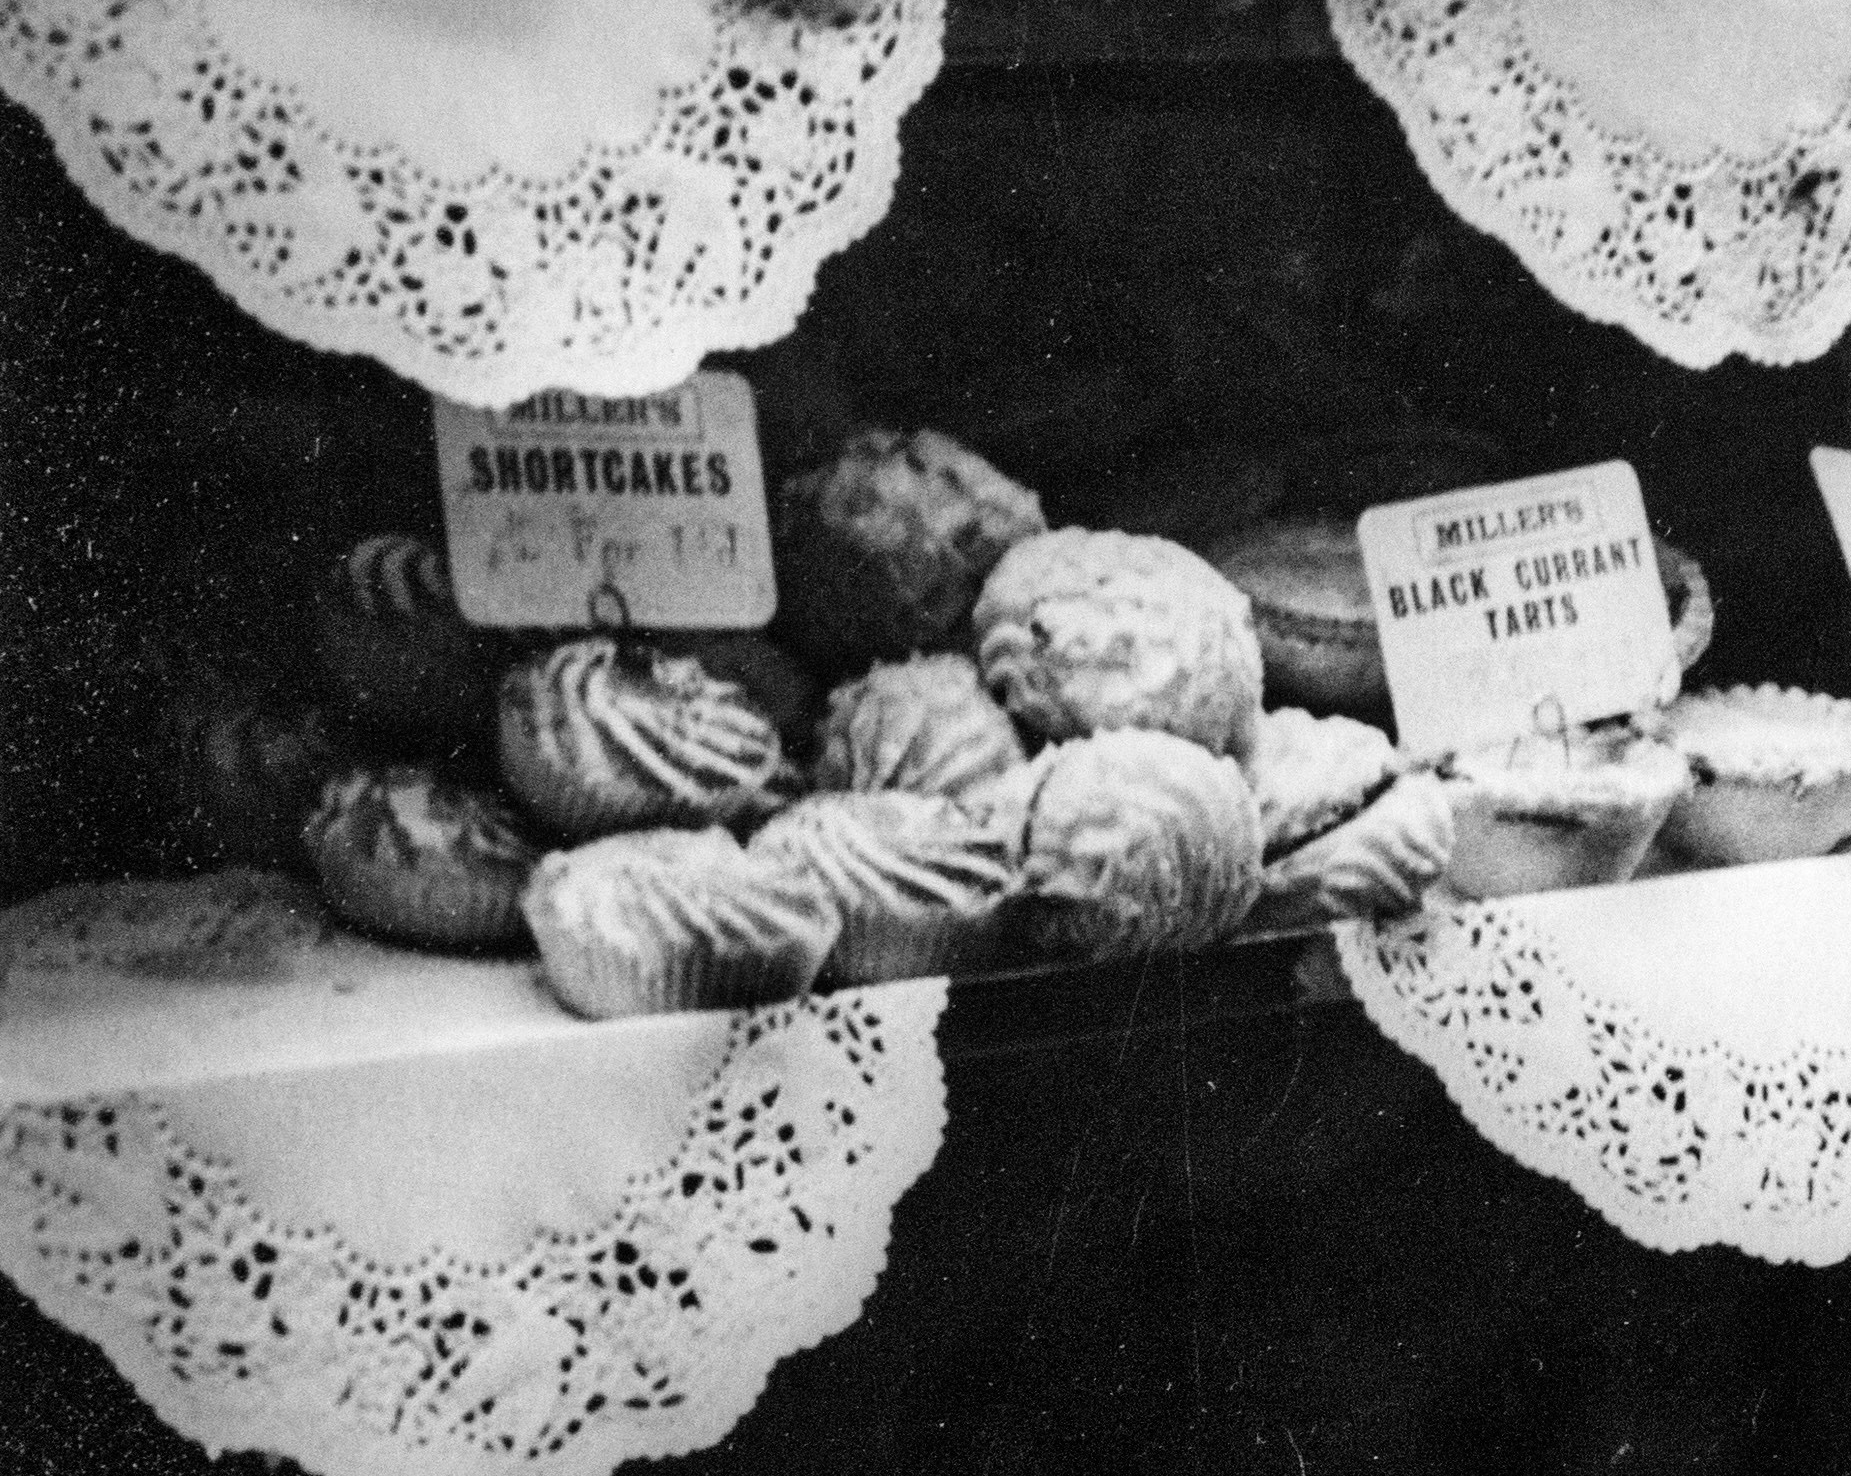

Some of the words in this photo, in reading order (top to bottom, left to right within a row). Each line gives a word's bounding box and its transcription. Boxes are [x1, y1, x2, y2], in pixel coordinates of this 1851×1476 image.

[469, 444, 733, 498] SHORTCAKES
[1432, 497, 1586, 552] MILLER'S
[1388, 566, 1491, 619] BLACK
[1513, 535, 1643, 592] CURRANT
[1484, 590, 1580, 642] TARTS
